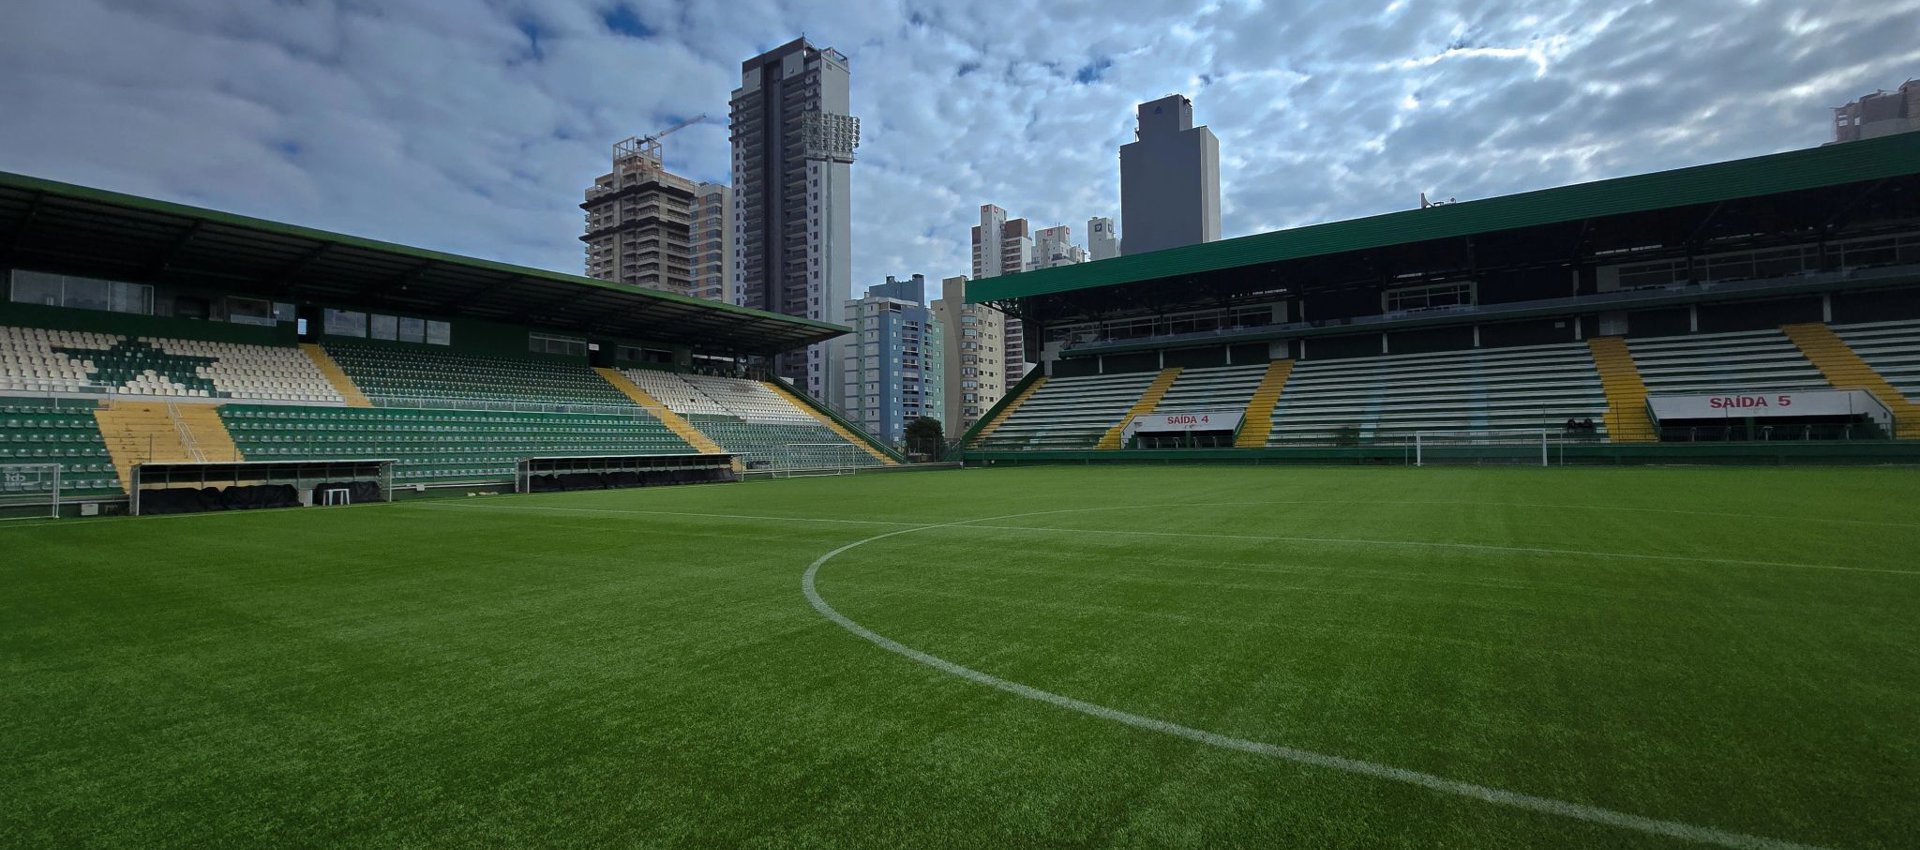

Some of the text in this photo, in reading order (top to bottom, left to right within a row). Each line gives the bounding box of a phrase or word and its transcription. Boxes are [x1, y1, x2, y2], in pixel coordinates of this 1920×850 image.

[1710, 395, 1791, 408] SAÍDA 5
[1167, 415, 1209, 425] SAÍDA 4
